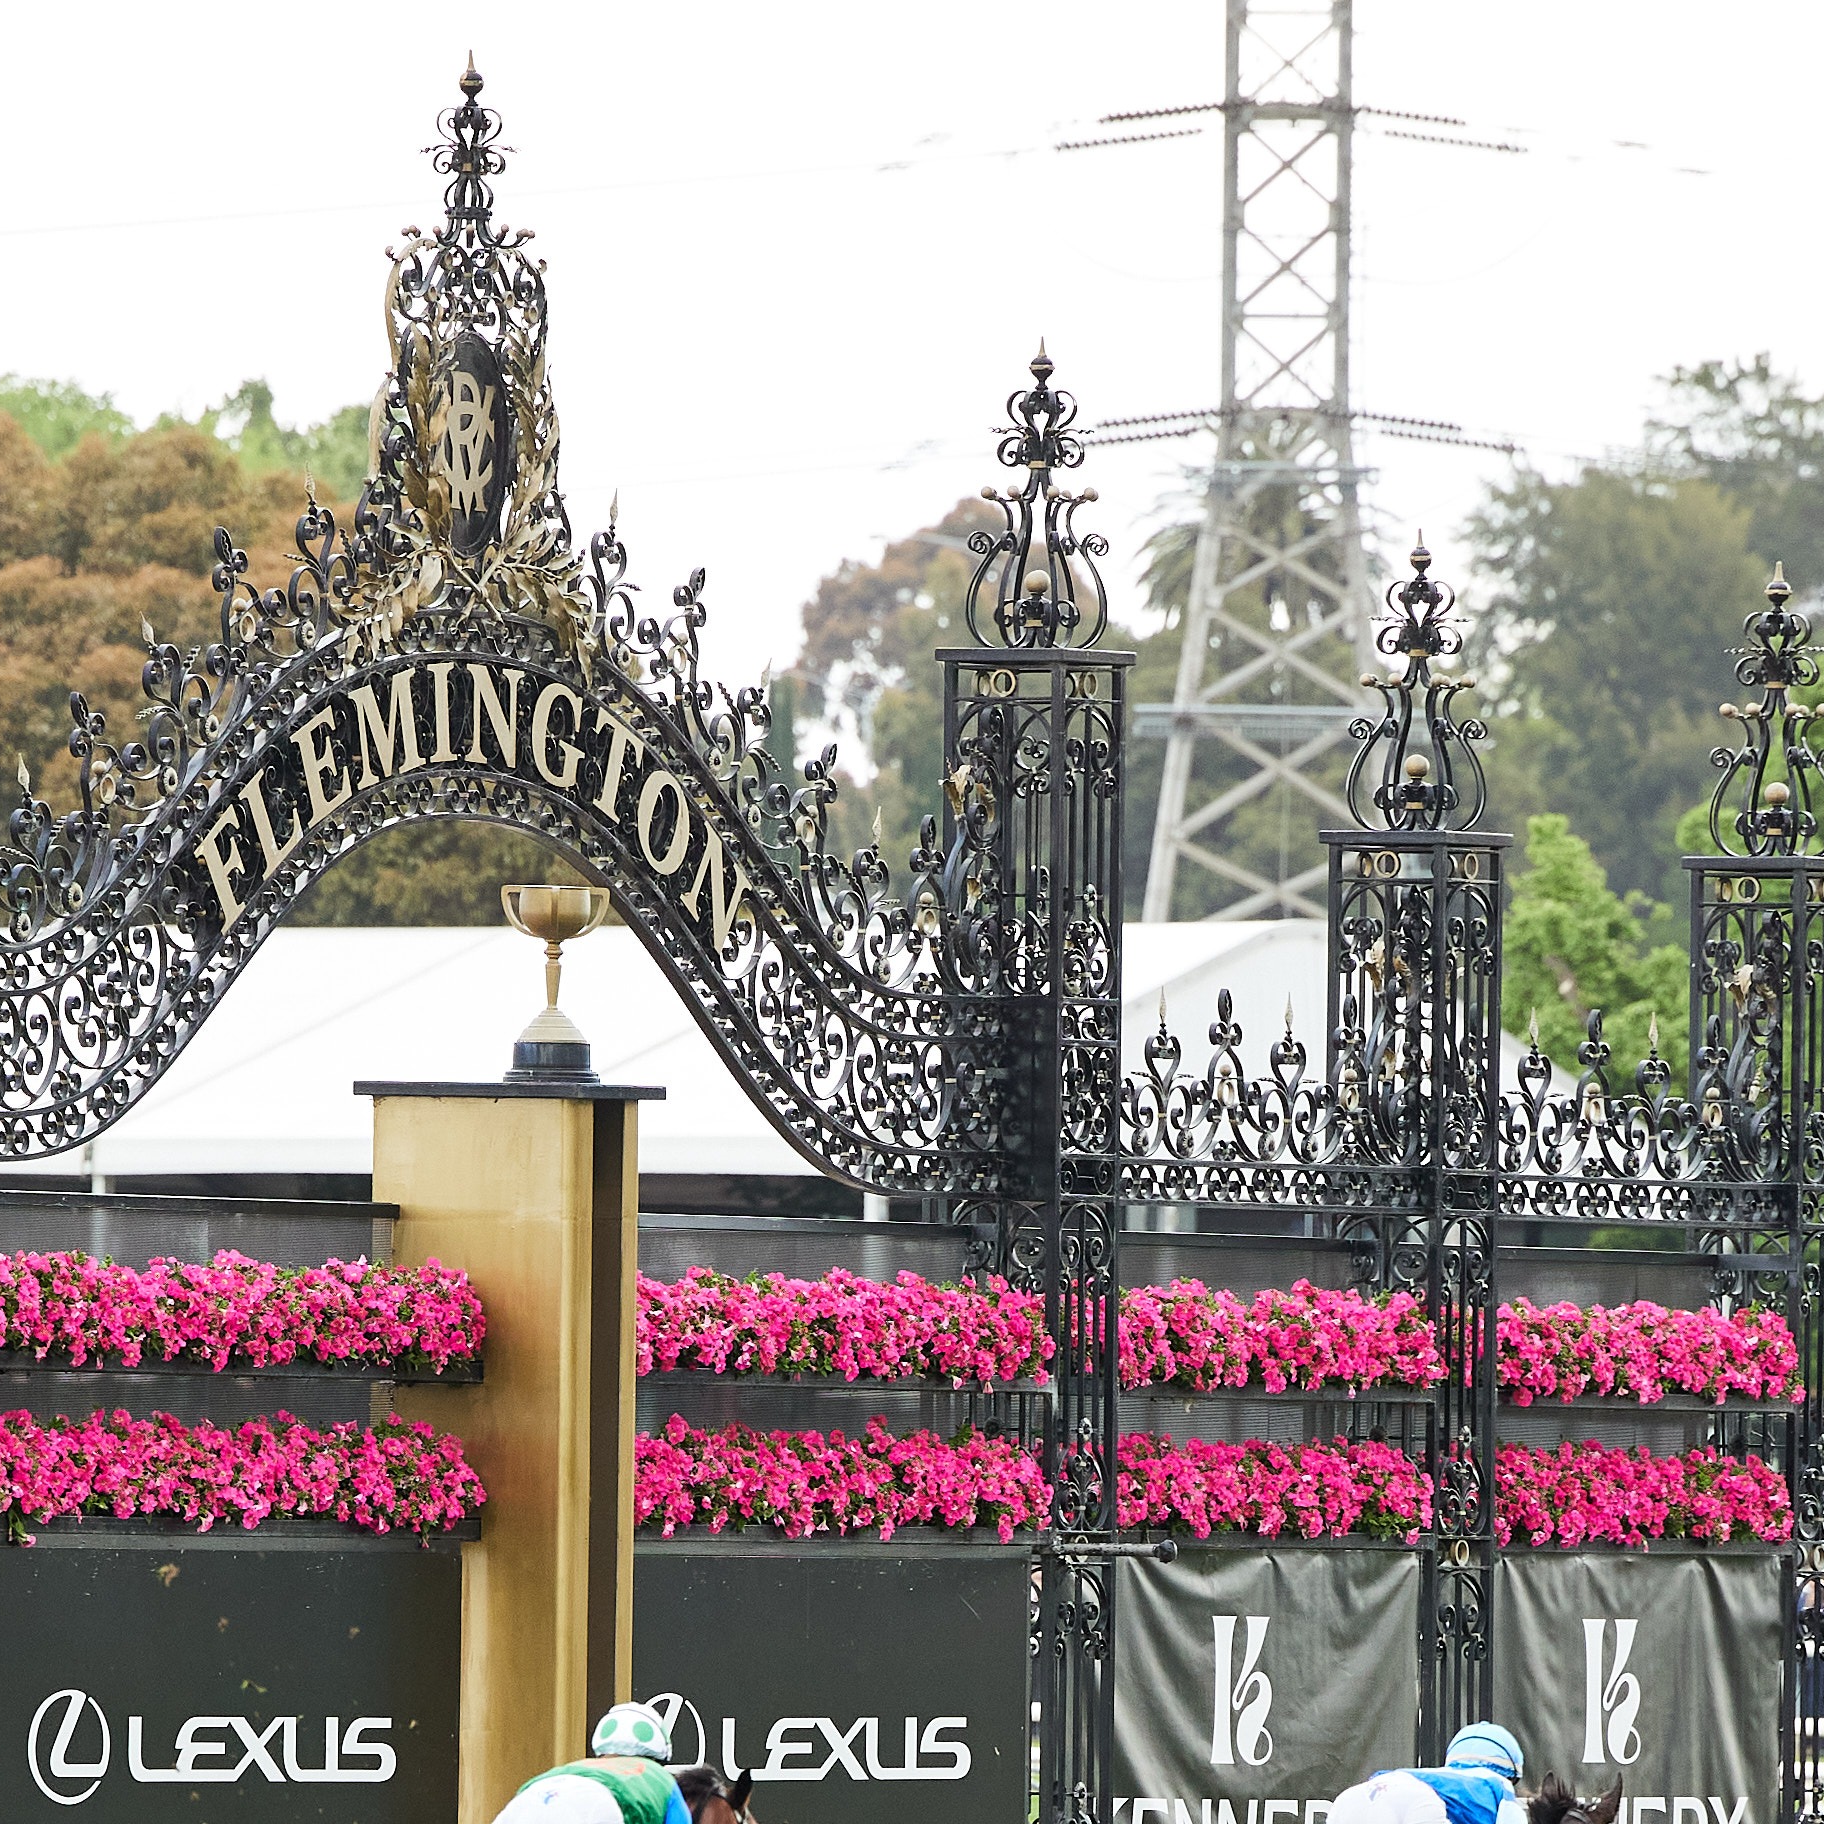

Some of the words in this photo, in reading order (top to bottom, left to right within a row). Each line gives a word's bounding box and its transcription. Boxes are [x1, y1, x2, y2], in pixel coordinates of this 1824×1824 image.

[195, 662, 751, 953] FLEMINGTON
[127, 1716, 397, 1784] LEXUS
[722, 1716, 972, 1782] LEXUS
